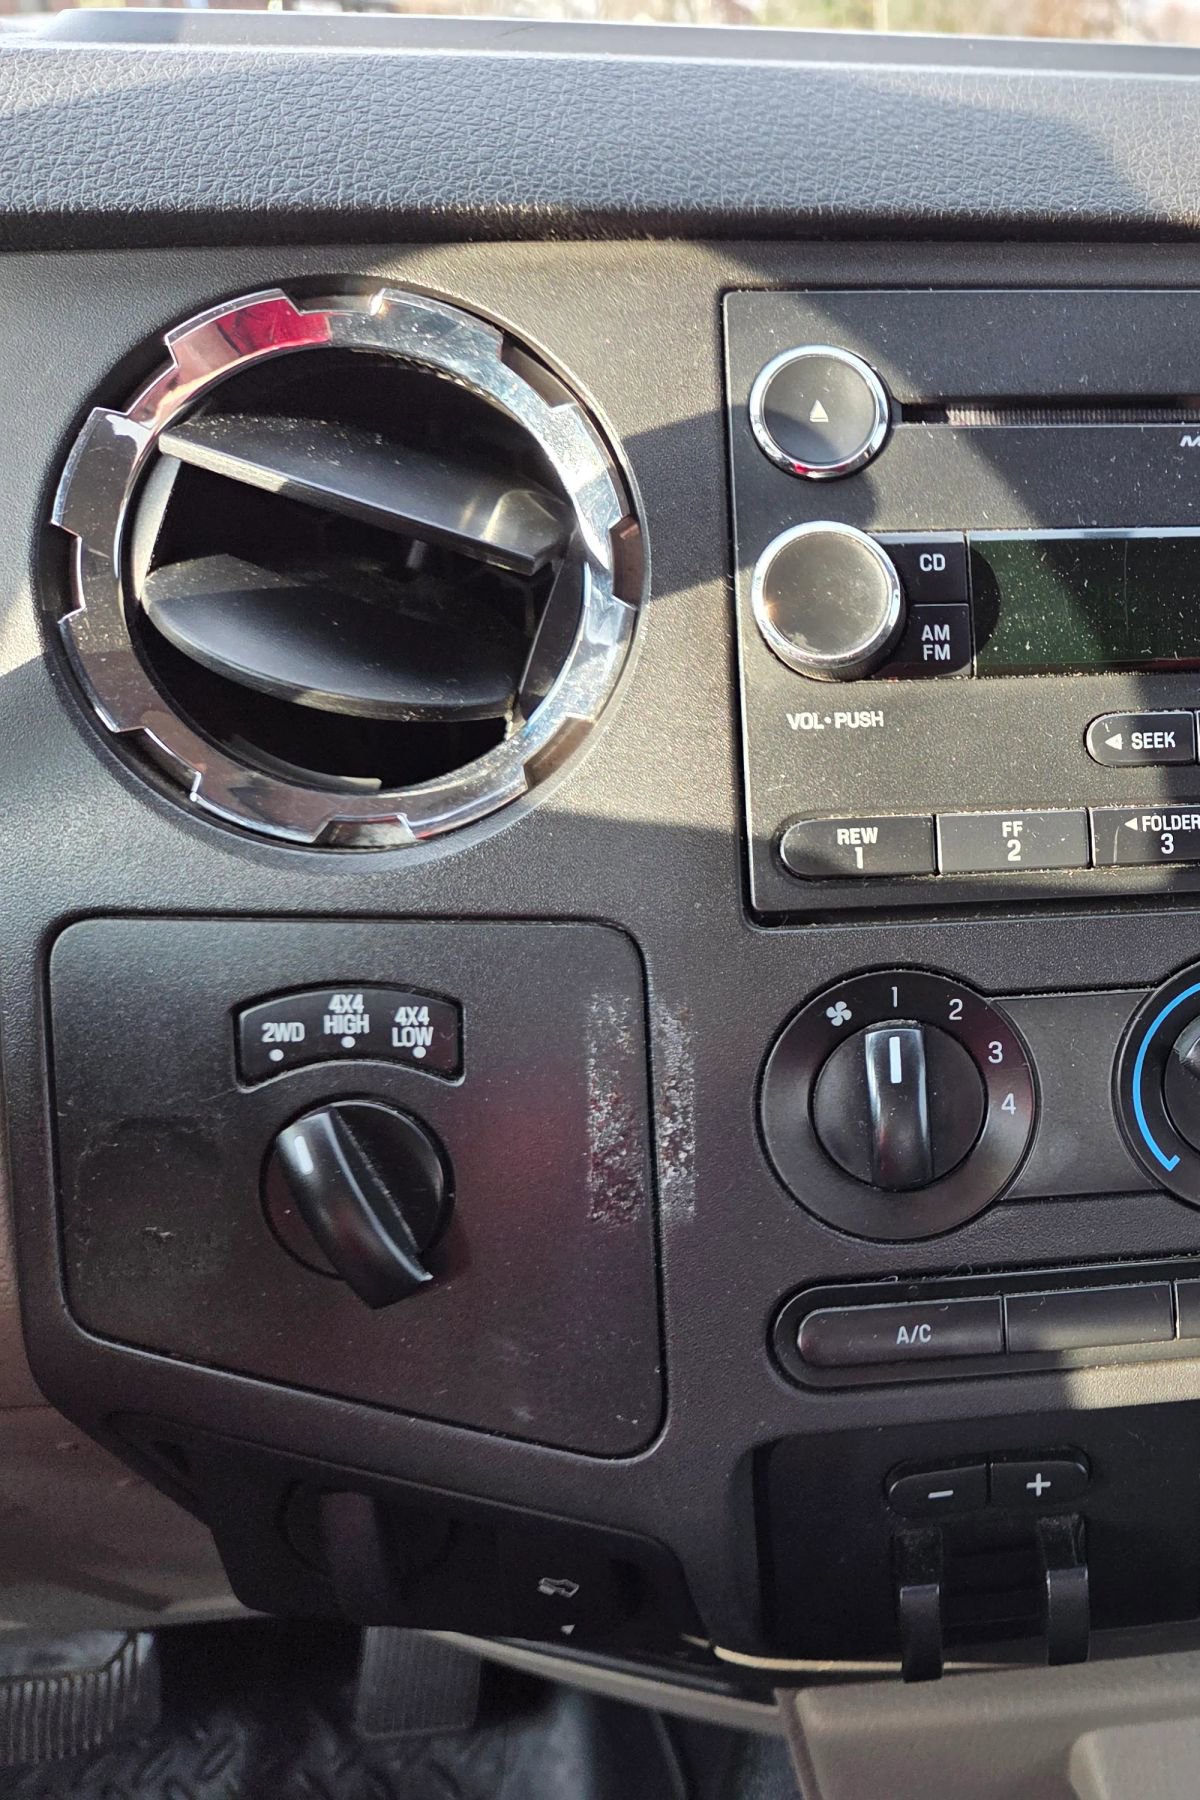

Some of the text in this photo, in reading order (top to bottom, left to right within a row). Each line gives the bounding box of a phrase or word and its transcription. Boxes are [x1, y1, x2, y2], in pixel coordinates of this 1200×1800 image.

[919, 554, 946, 572] CD
[921, 624, 951, 642] AM
[922, 644, 951, 661] FM
[1130, 732, 1176, 750] SEEK
[836, 827, 879, 846] REW
[1001, 821, 1023, 838] FF
[1006, 840, 1022, 862] 2
[1160, 833, 1175, 855] 3
[854, 847, 864, 870] 1
[328, 994, 365, 1014] 4X4
[890, 986, 899, 1008] 1
[394, 1006, 430, 1027] 4X4
[948, 999, 963, 1021] 2
[261, 1022, 306, 1043] 2WD
[324, 1014, 369, 1034] HIGH
[392, 1028, 433, 1047] LOW
[988, 1041, 1003, 1064] 3
[1000, 1093, 1017, 1116] 4
[896, 1324, 932, 1345] A/C
